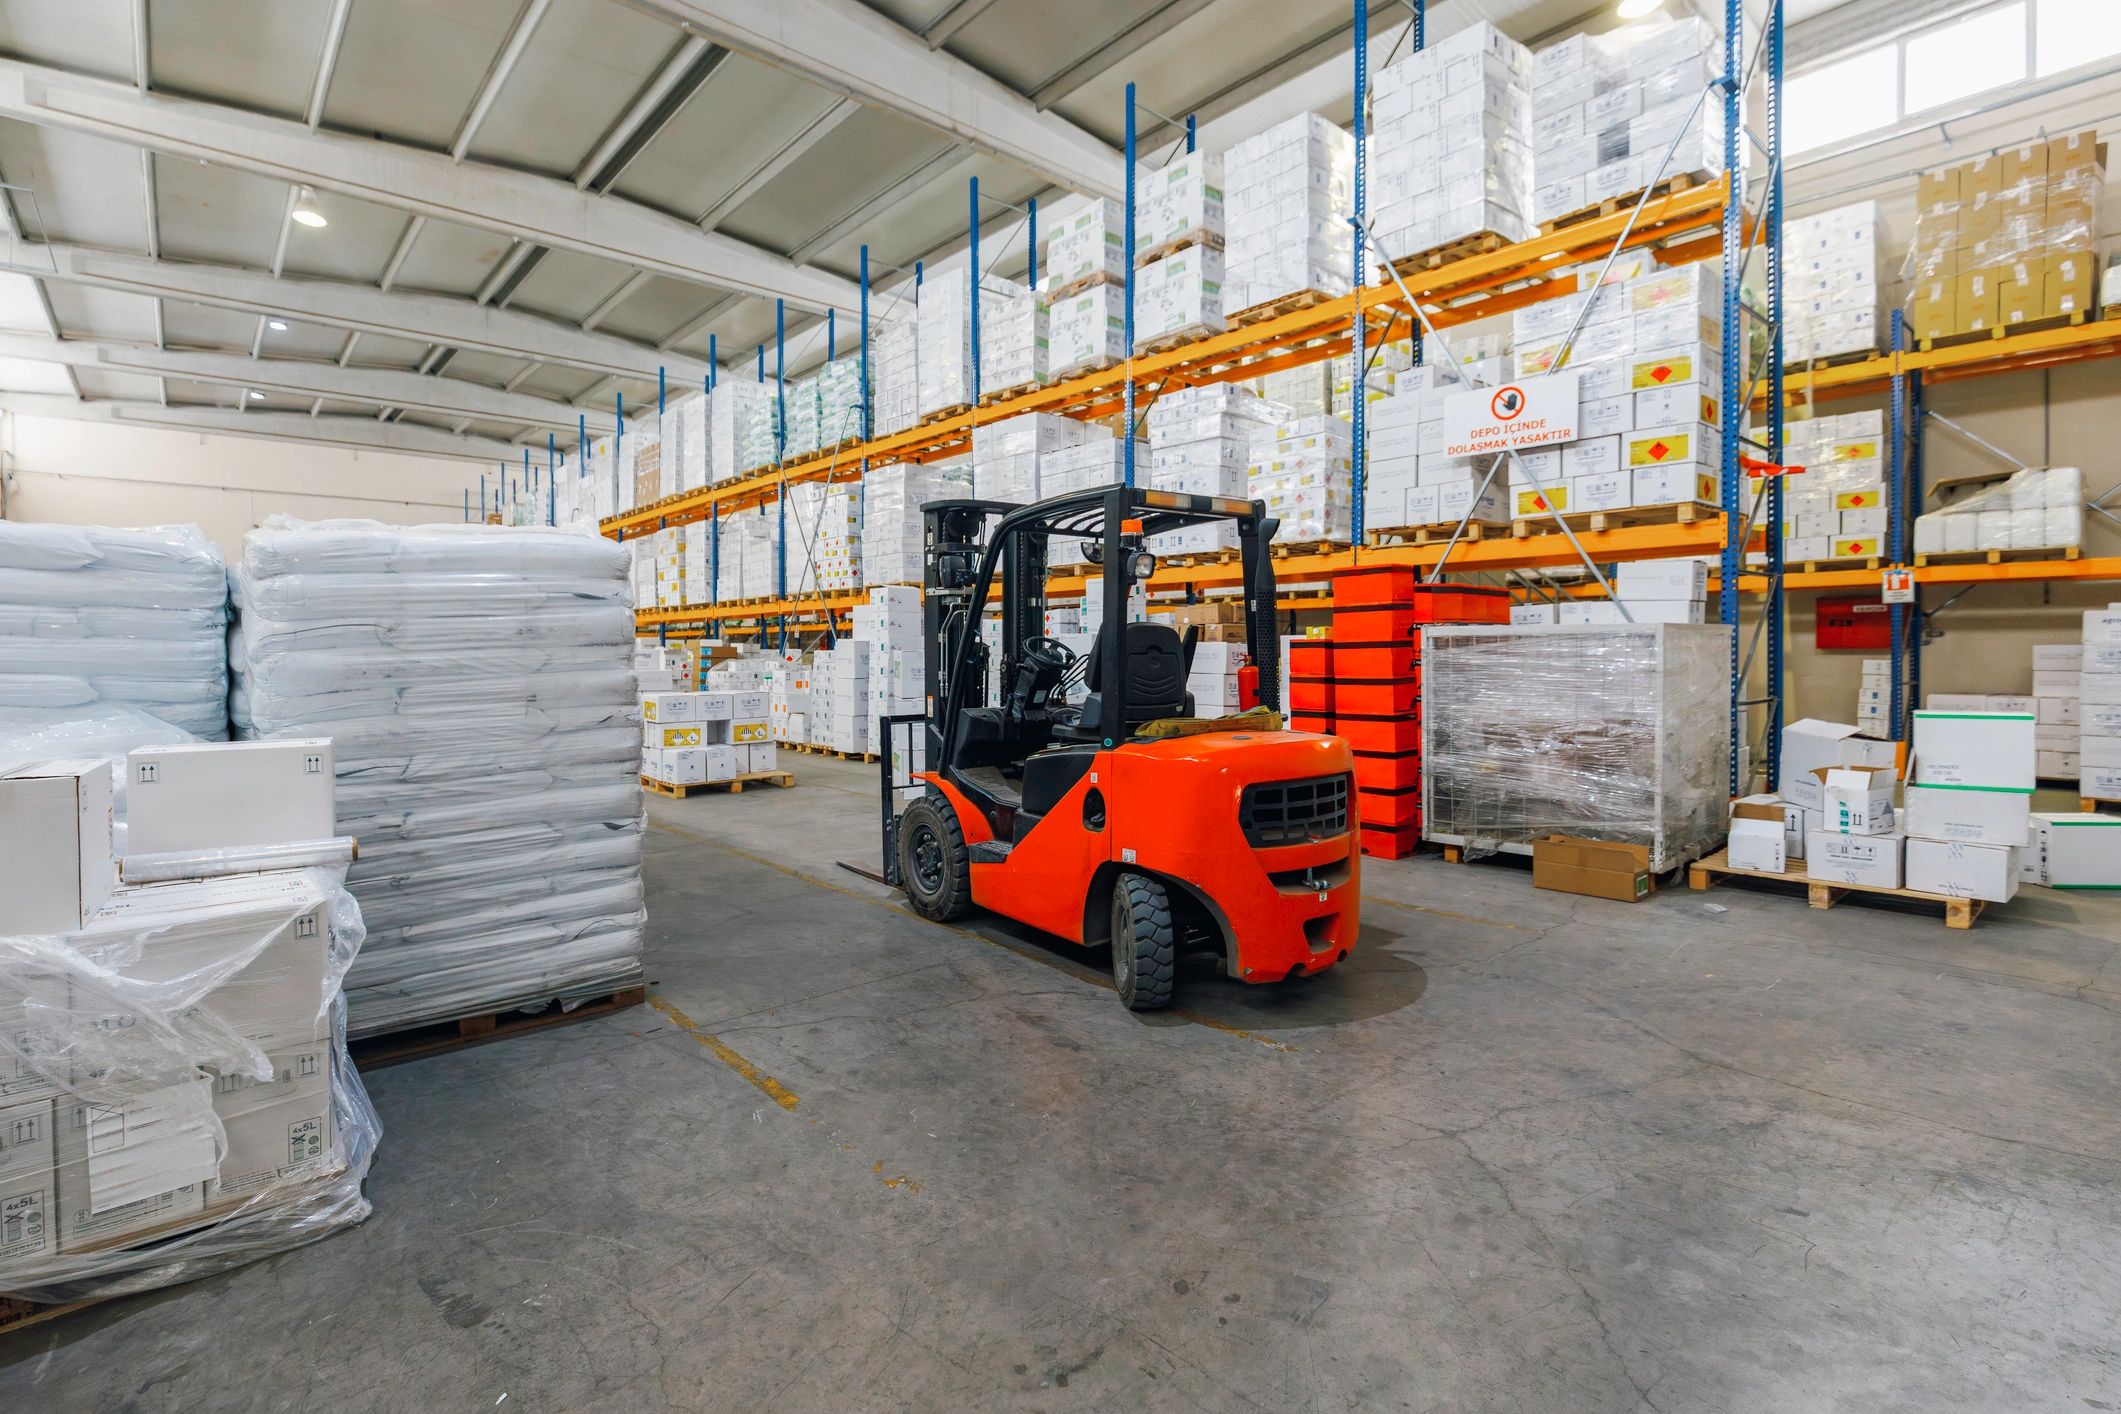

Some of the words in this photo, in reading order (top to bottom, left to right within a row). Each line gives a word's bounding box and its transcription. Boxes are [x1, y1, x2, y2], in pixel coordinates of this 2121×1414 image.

[1470, 426, 1500, 438] DEPO
[1504, 418, 1546, 434] İÇİNDE
[1448, 439, 1508, 455] DOLAŞMAK
[1512, 429, 1571, 445] YASAKTIR
[292, 1121, 317, 1133] 4x5L
[6, 1196, 39, 1210] 4x5L
